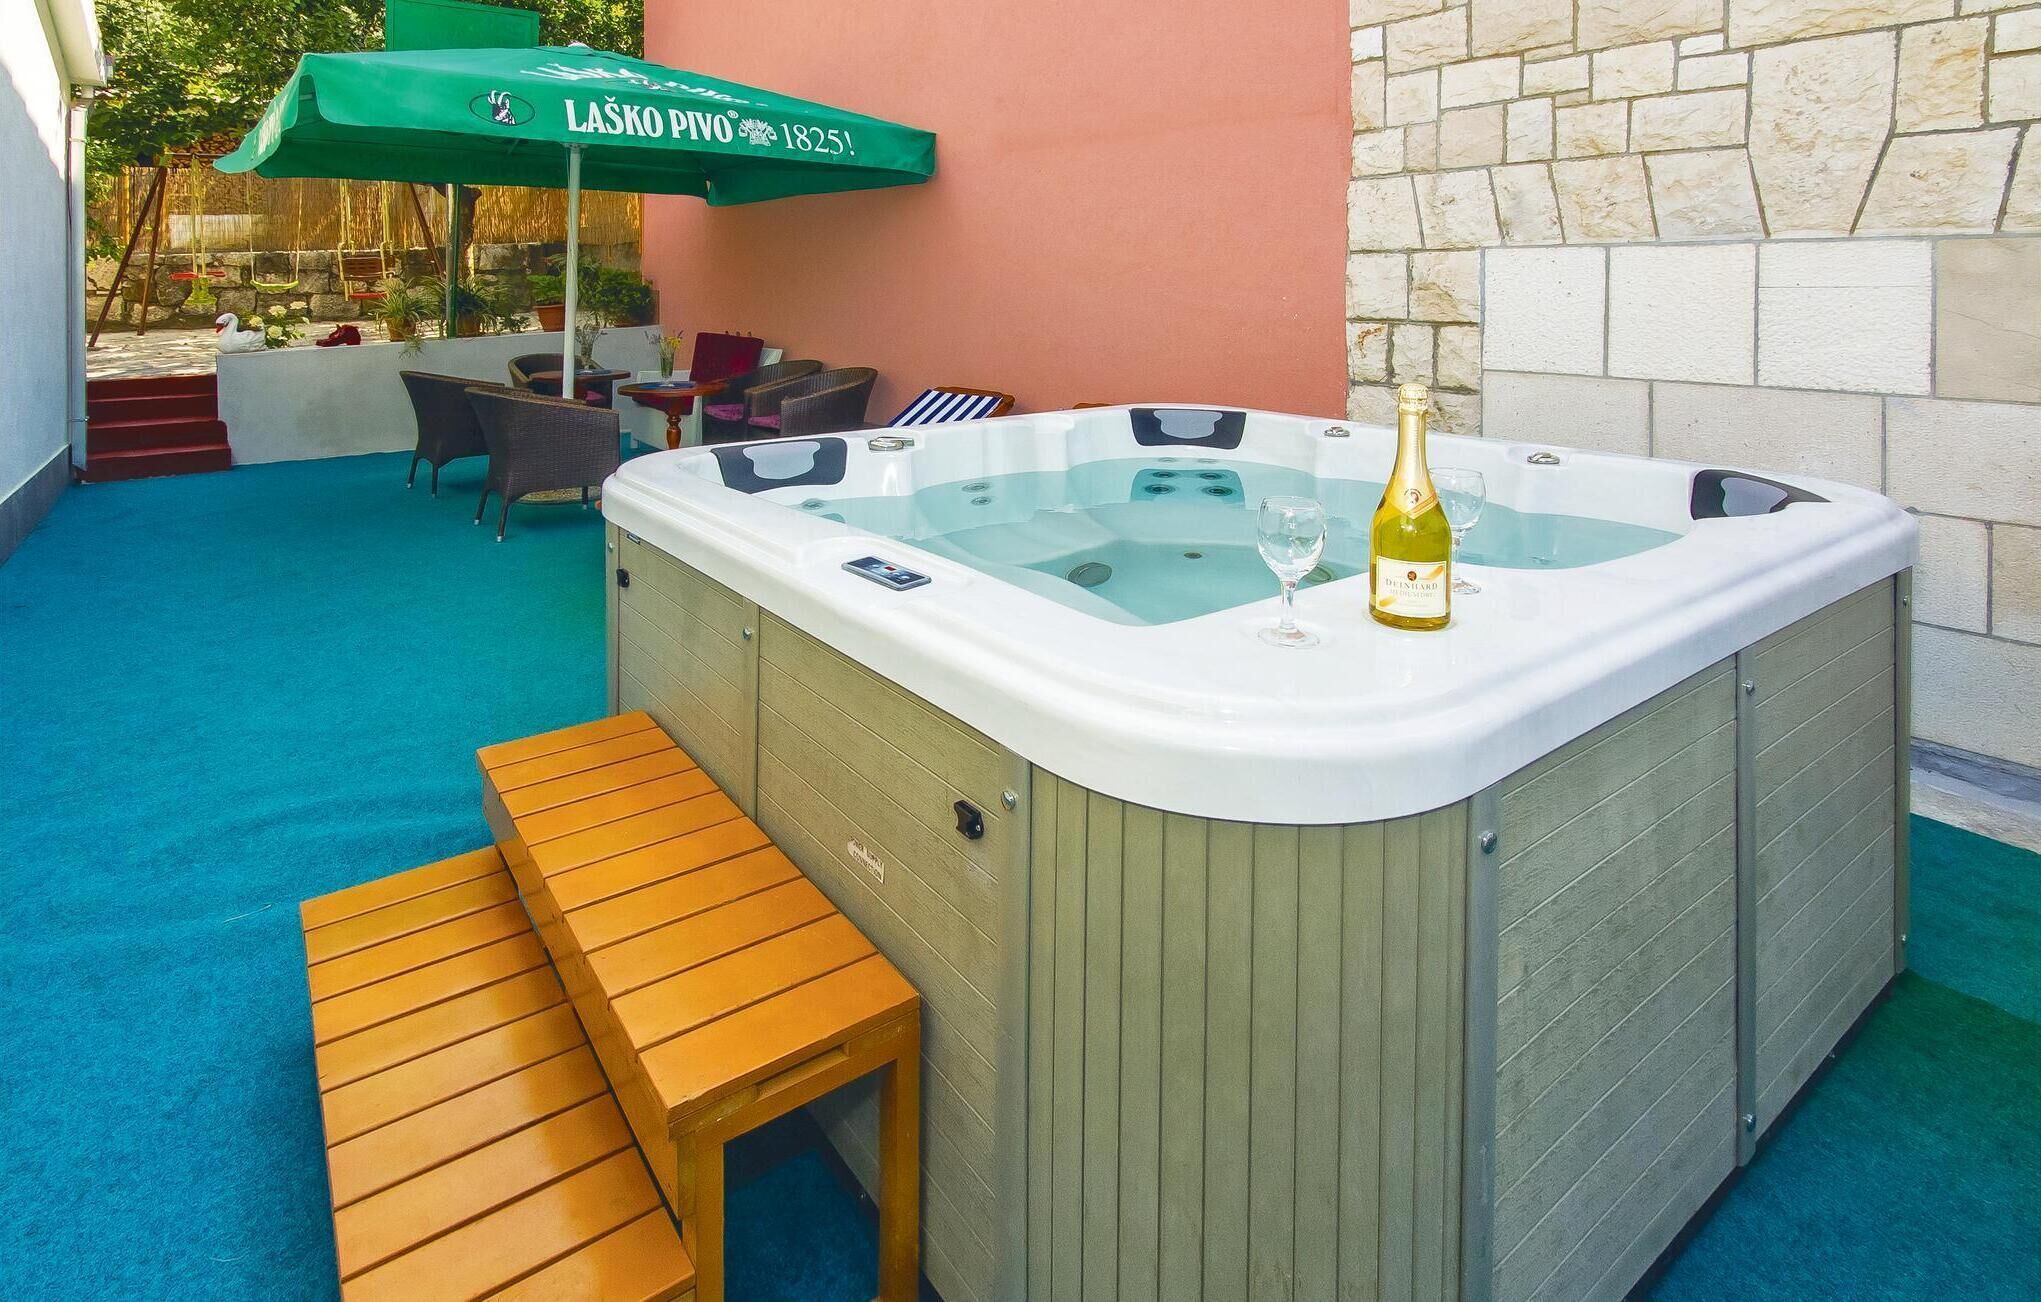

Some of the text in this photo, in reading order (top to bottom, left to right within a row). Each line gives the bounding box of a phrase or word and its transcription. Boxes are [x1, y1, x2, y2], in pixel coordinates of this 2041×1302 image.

[564, 95, 664, 138] LAŠKO
[779, 122, 856, 156] 1825!
[1385, 578, 1438, 590] DEINHARD
